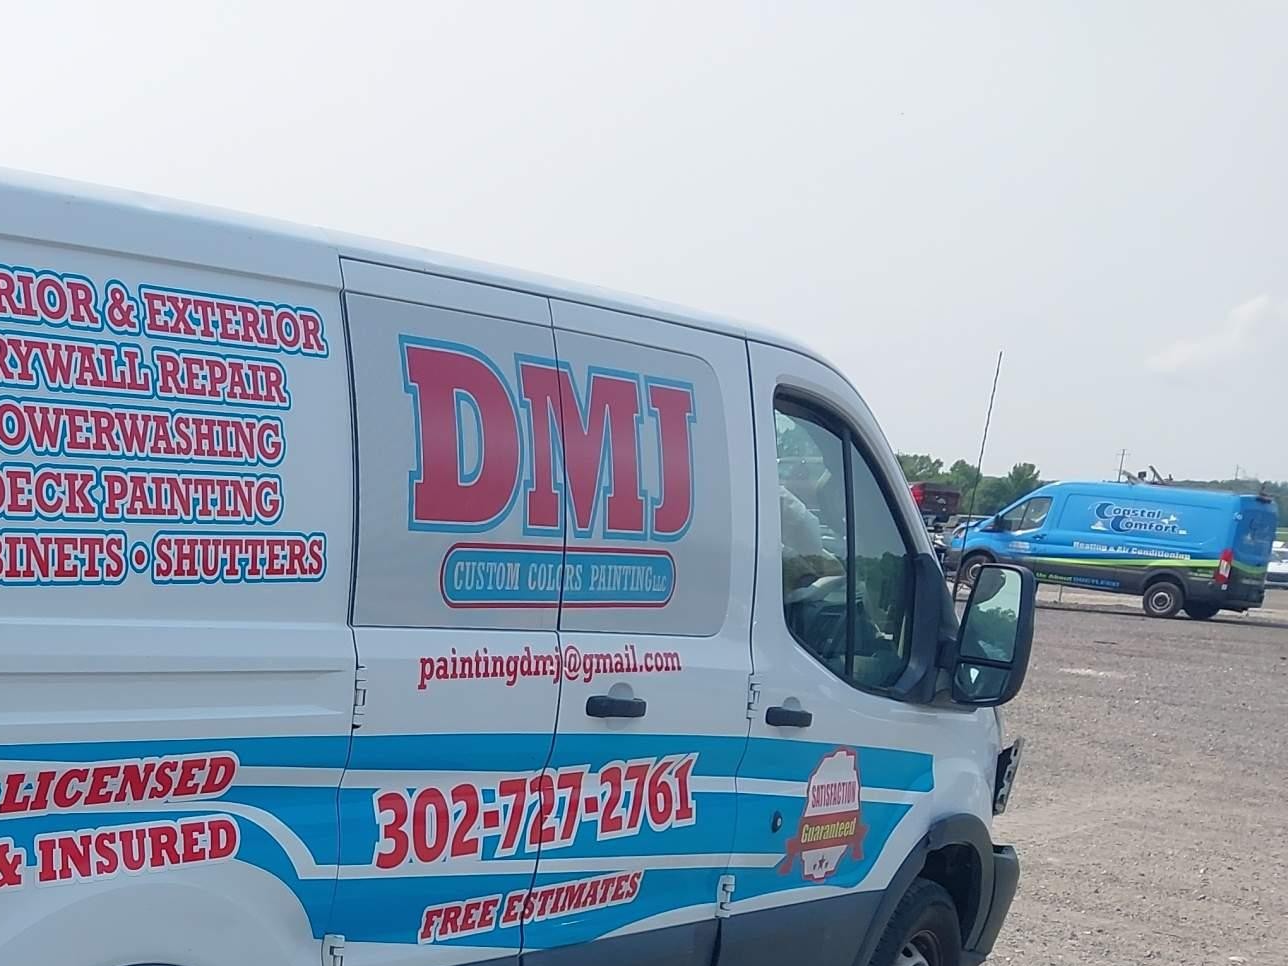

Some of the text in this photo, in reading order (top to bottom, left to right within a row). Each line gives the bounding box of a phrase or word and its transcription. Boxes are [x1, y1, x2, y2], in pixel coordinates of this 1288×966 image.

[107, 286, 138, 329] &
[143, 291, 326, 353] EXTERIOR
[157, 353, 288, 404] REPAIR
[399, 333, 697, 543] DMJ
[103, 474, 281, 520] PAINTING
[1095, 502, 1161, 520] Coastal
[1110, 516, 1178, 533] Comfort
[154, 536, 324, 578] SHUTTERS
[1073, 541, 1108, 552] Heating
[1132, 547, 1191, 560] Conditioning
[453, 561, 520, 591] CUSTOM
[527, 563, 583, 591] COLORS
[589, 564, 653, 592] PAINTING
[417, 645, 682, 690] paintingdmj@gmail.com
[374, 756, 695, 869] 302-727-2761
[811, 781, 857, 809] SATISFACTION
[37, 820, 238, 883] INSURED
[800, 817, 857, 843] Guaranteed
[420, 872, 643, 942] FREE ESTIMATES
